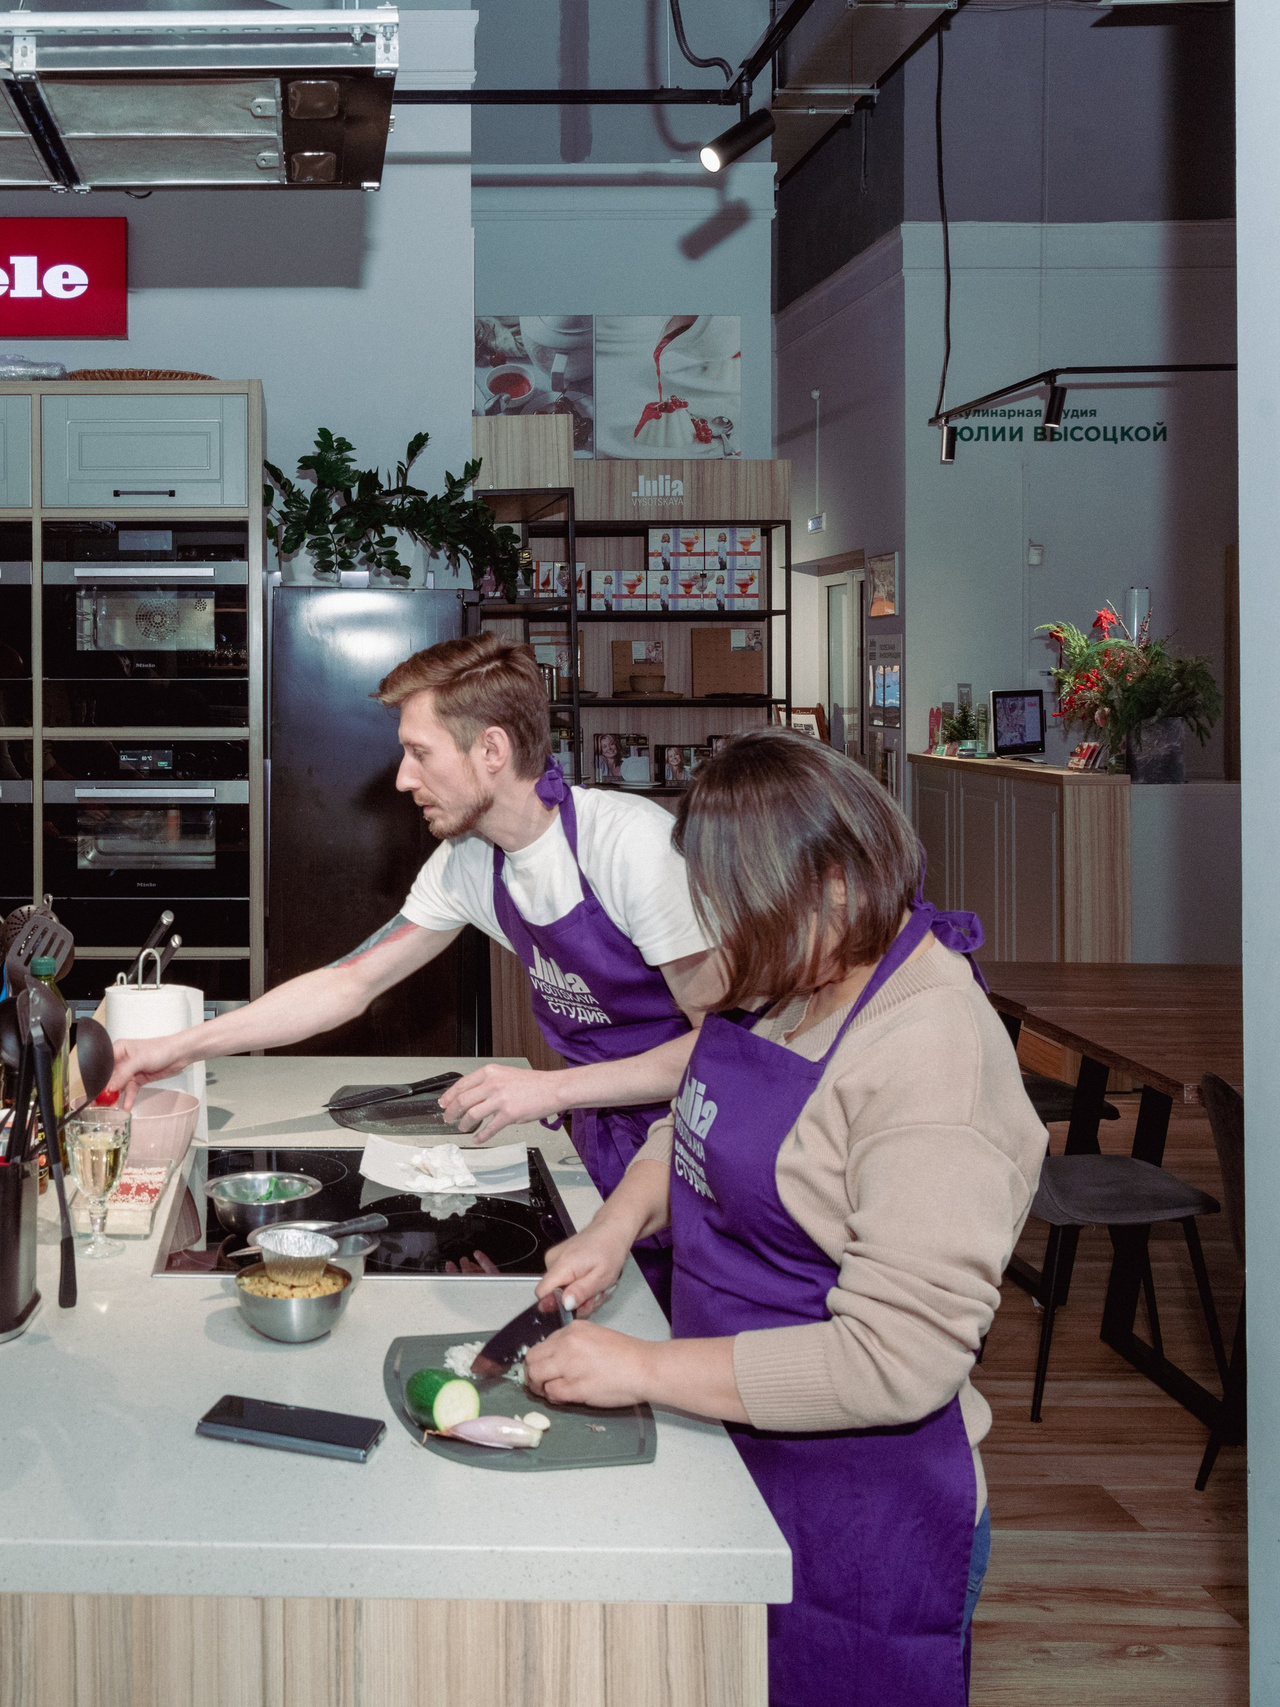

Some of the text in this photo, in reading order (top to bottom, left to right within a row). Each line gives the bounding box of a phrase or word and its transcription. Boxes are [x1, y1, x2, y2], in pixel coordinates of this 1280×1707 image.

[1062, 409, 1097, 419] удия
[955, 421, 1167, 444] ЮЛИИ ВЫСОЦКОЙ
[631, 474, 684, 497] Julia
[631, 497, 684, 507] VYSOTSKAYA
[530, 976, 600, 1005] VYSOTSKAYA
[548, 1001, 612, 1025] СТУДИЯ
